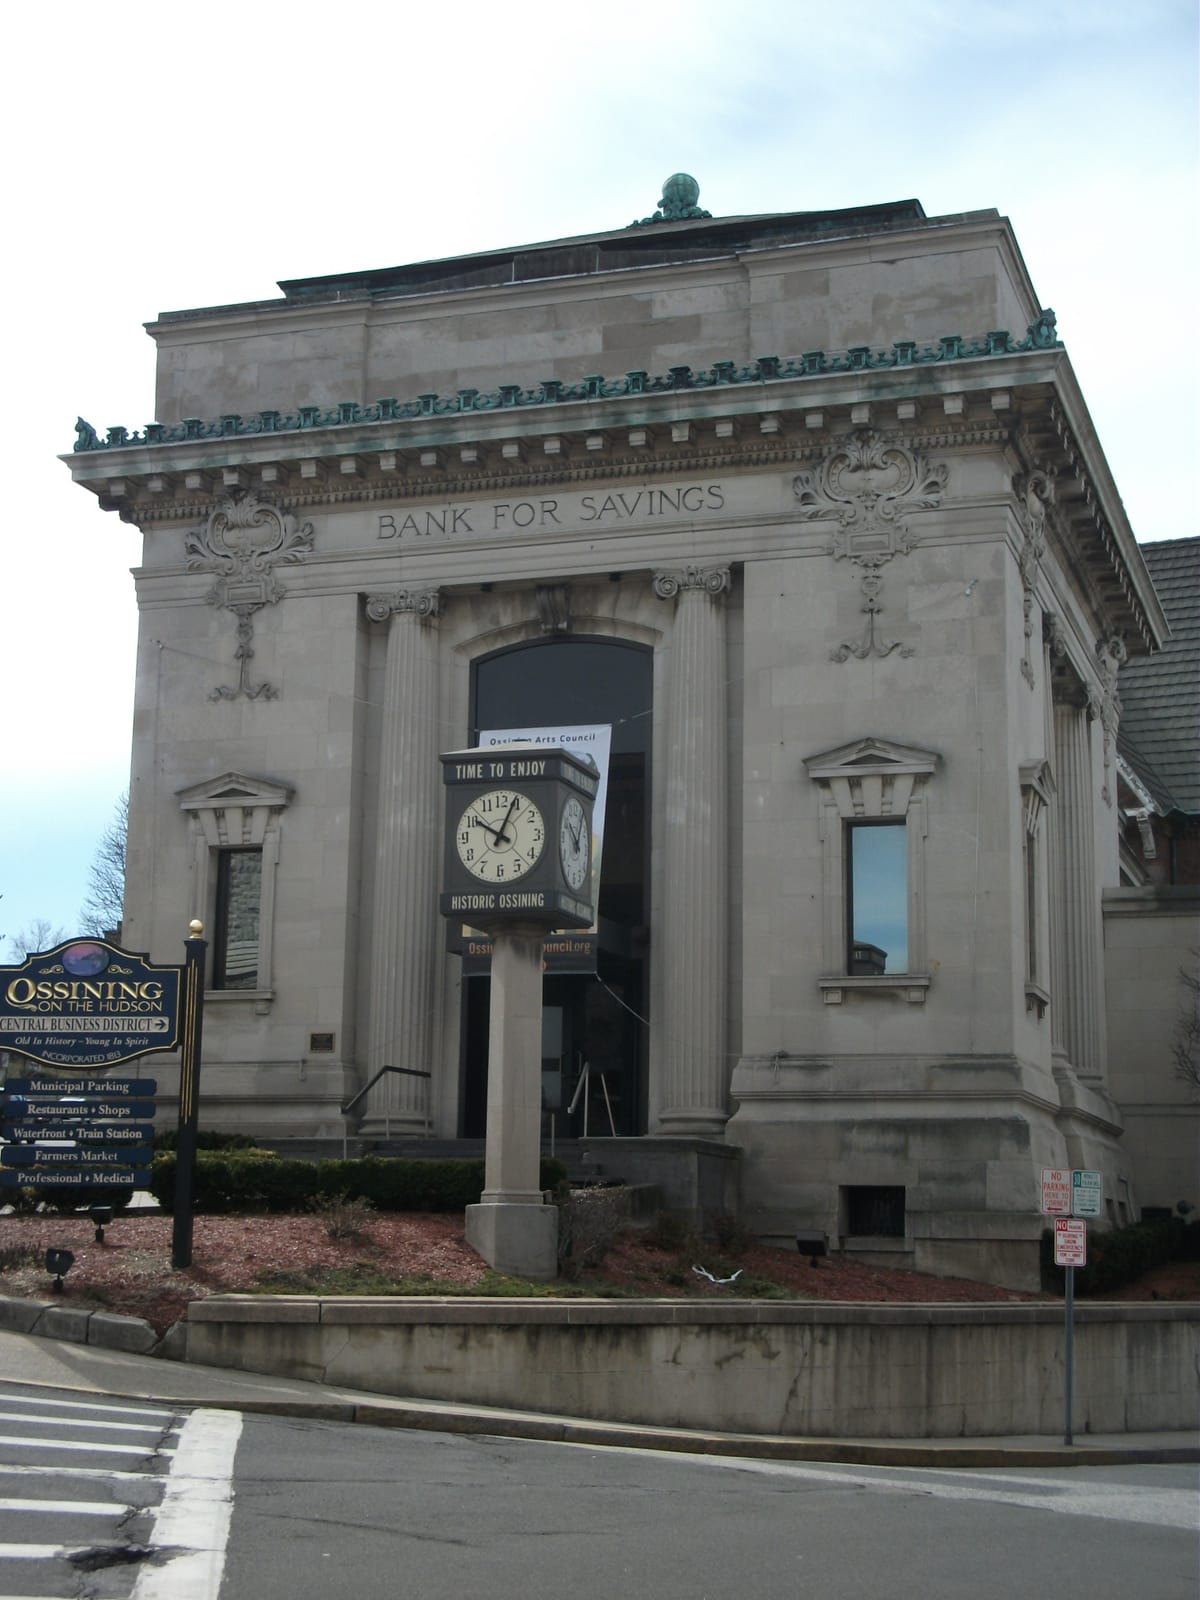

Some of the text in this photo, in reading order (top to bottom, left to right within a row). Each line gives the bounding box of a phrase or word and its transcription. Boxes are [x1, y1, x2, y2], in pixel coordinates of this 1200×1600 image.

[377, 484, 725, 540] BANK FOR SAVINGS
[535, 735, 556, 743] Arts
[559, 733, 596, 743] Council
[456, 764, 483, 780] TIME
[489, 763, 504, 778] TO
[510, 761, 546, 776] ENJOY
[452, 895, 495, 909] HISTORIC
[499, 893, 545, 908] OSSINING
[5, 978, 163, 1009] OSSINING
[38, 1001, 162, 1012] ON THE HUDSON
[0, 1018, 152, 1031] CENTRAL BUSINESS DISTRICT
[15, 1036, 31, 1045] Old
[33, 1037, 42, 1045] In
[45, 1036, 76, 1047] History
[85, 1037, 110, 1047] Young
[113, 1037, 122, 1045] In
[125, 1036, 149, 1047] Spirit
[42, 1050, 105, 1063] INCORPORATED
[30, 1081, 129, 1094] Municipal Parking
[27, 1104, 130, 1117] Restaurants Shops
[13, 1128, 142, 1139] Waterfront Train Station
[35, 1151, 117, 1161] Farmers Market
[17, 1173, 134, 1183] Professional Medical
[1051, 1172, 1062, 1180] NO
[1043, 1183, 1070, 1192] PARKING
[1056, 1221, 1067, 1231] NO
